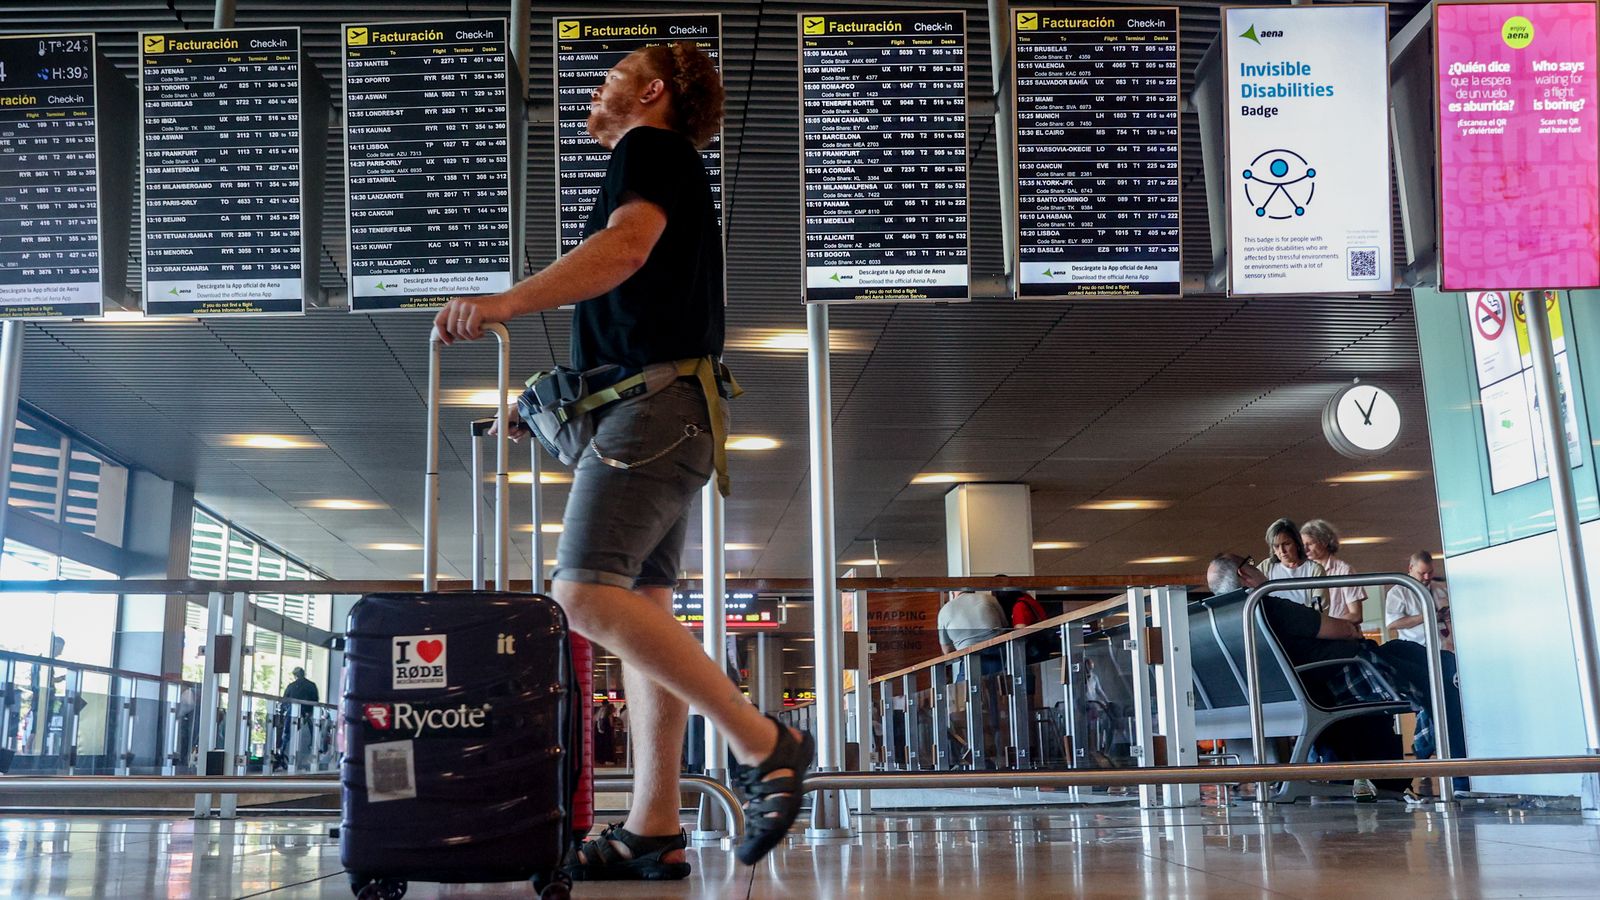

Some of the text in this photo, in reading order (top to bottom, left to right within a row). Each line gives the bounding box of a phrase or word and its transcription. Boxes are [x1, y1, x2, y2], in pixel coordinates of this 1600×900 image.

[830, 21, 952, 32] Facturación Check-in
[1043, 16, 1165, 28] Facturación Check-in
[372, 30, 493, 42] Facturación Check-in
[584, 24, 707, 36] Facturación Check-in
[169, 38, 287, 51] Facturación Check-in
[1241, 62, 1310, 76] Invisible
[1448, 61, 1510, 75] ¿Quién dice
[1533, 61, 1584, 72] Who says
[1451, 76, 1511, 87] que la espera
[1535, 74, 1582, 86] waiting for
[1242, 83, 1334, 98] Disabilities
[1456, 88, 1506, 98] de un vuelo
[1544, 88, 1574, 100] a flight
[48, 96, 84, 104] Check-in
[1449, 100, 1514, 112] es aburrida?
[1534, 100, 1585, 112] is boring?
[1242, 106, 1278, 117] Badge
[1497, 119, 1506, 127] QR
[497, 633, 515, 654] it
[396, 641, 410, 664] I
[397, 666, 443, 678] RØDE
[394, 704, 485, 738] Rycote
